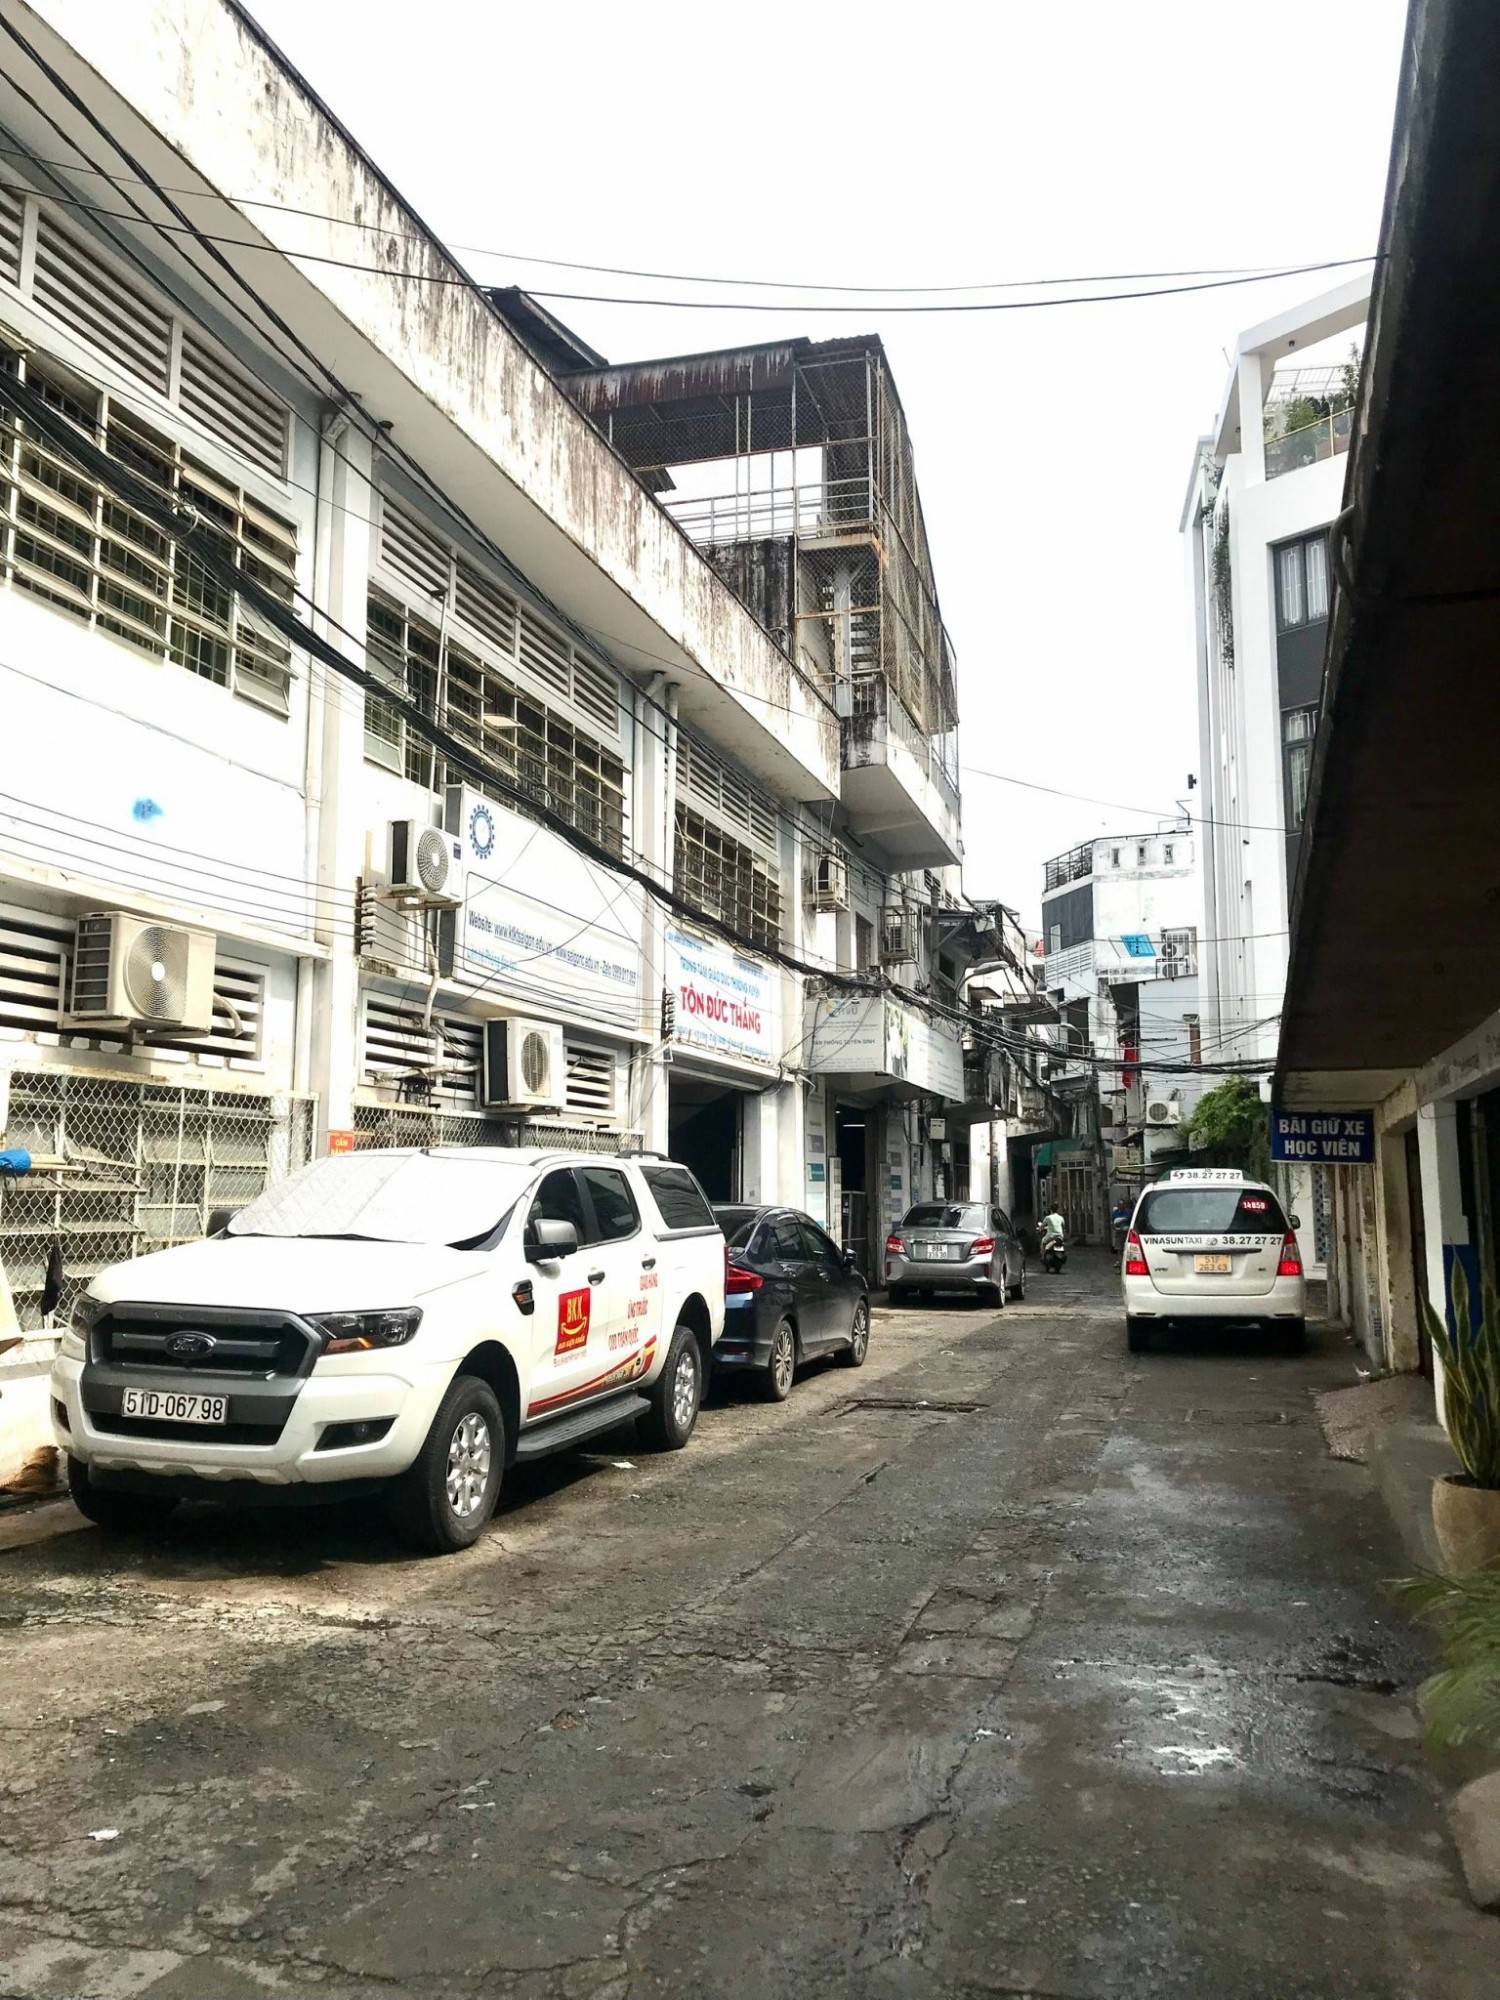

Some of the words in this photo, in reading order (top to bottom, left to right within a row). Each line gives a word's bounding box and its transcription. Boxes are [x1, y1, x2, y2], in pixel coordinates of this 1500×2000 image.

[680, 982, 705, 1014] TÔN
[706, 990, 728, 1023] ĐỨC
[729, 996, 761, 1034] THẮNG
[1278, 1116, 1307, 1134] BÃI
[1311, 1117, 1341, 1135] GIỮ
[1344, 1120, 1365, 1135] XE
[1284, 1139, 1317, 1158] HỌC
[1321, 1138, 1360, 1156] VIÊN
[1222, 1236, 1252, 1245] 38.27
[1254, 1236, 1267, 1245] 27
[1270, 1236, 1282, 1246] 27
[1204, 1256, 1220, 1264] 51F
[126, 1391, 224, 1421] 51D-067.98
